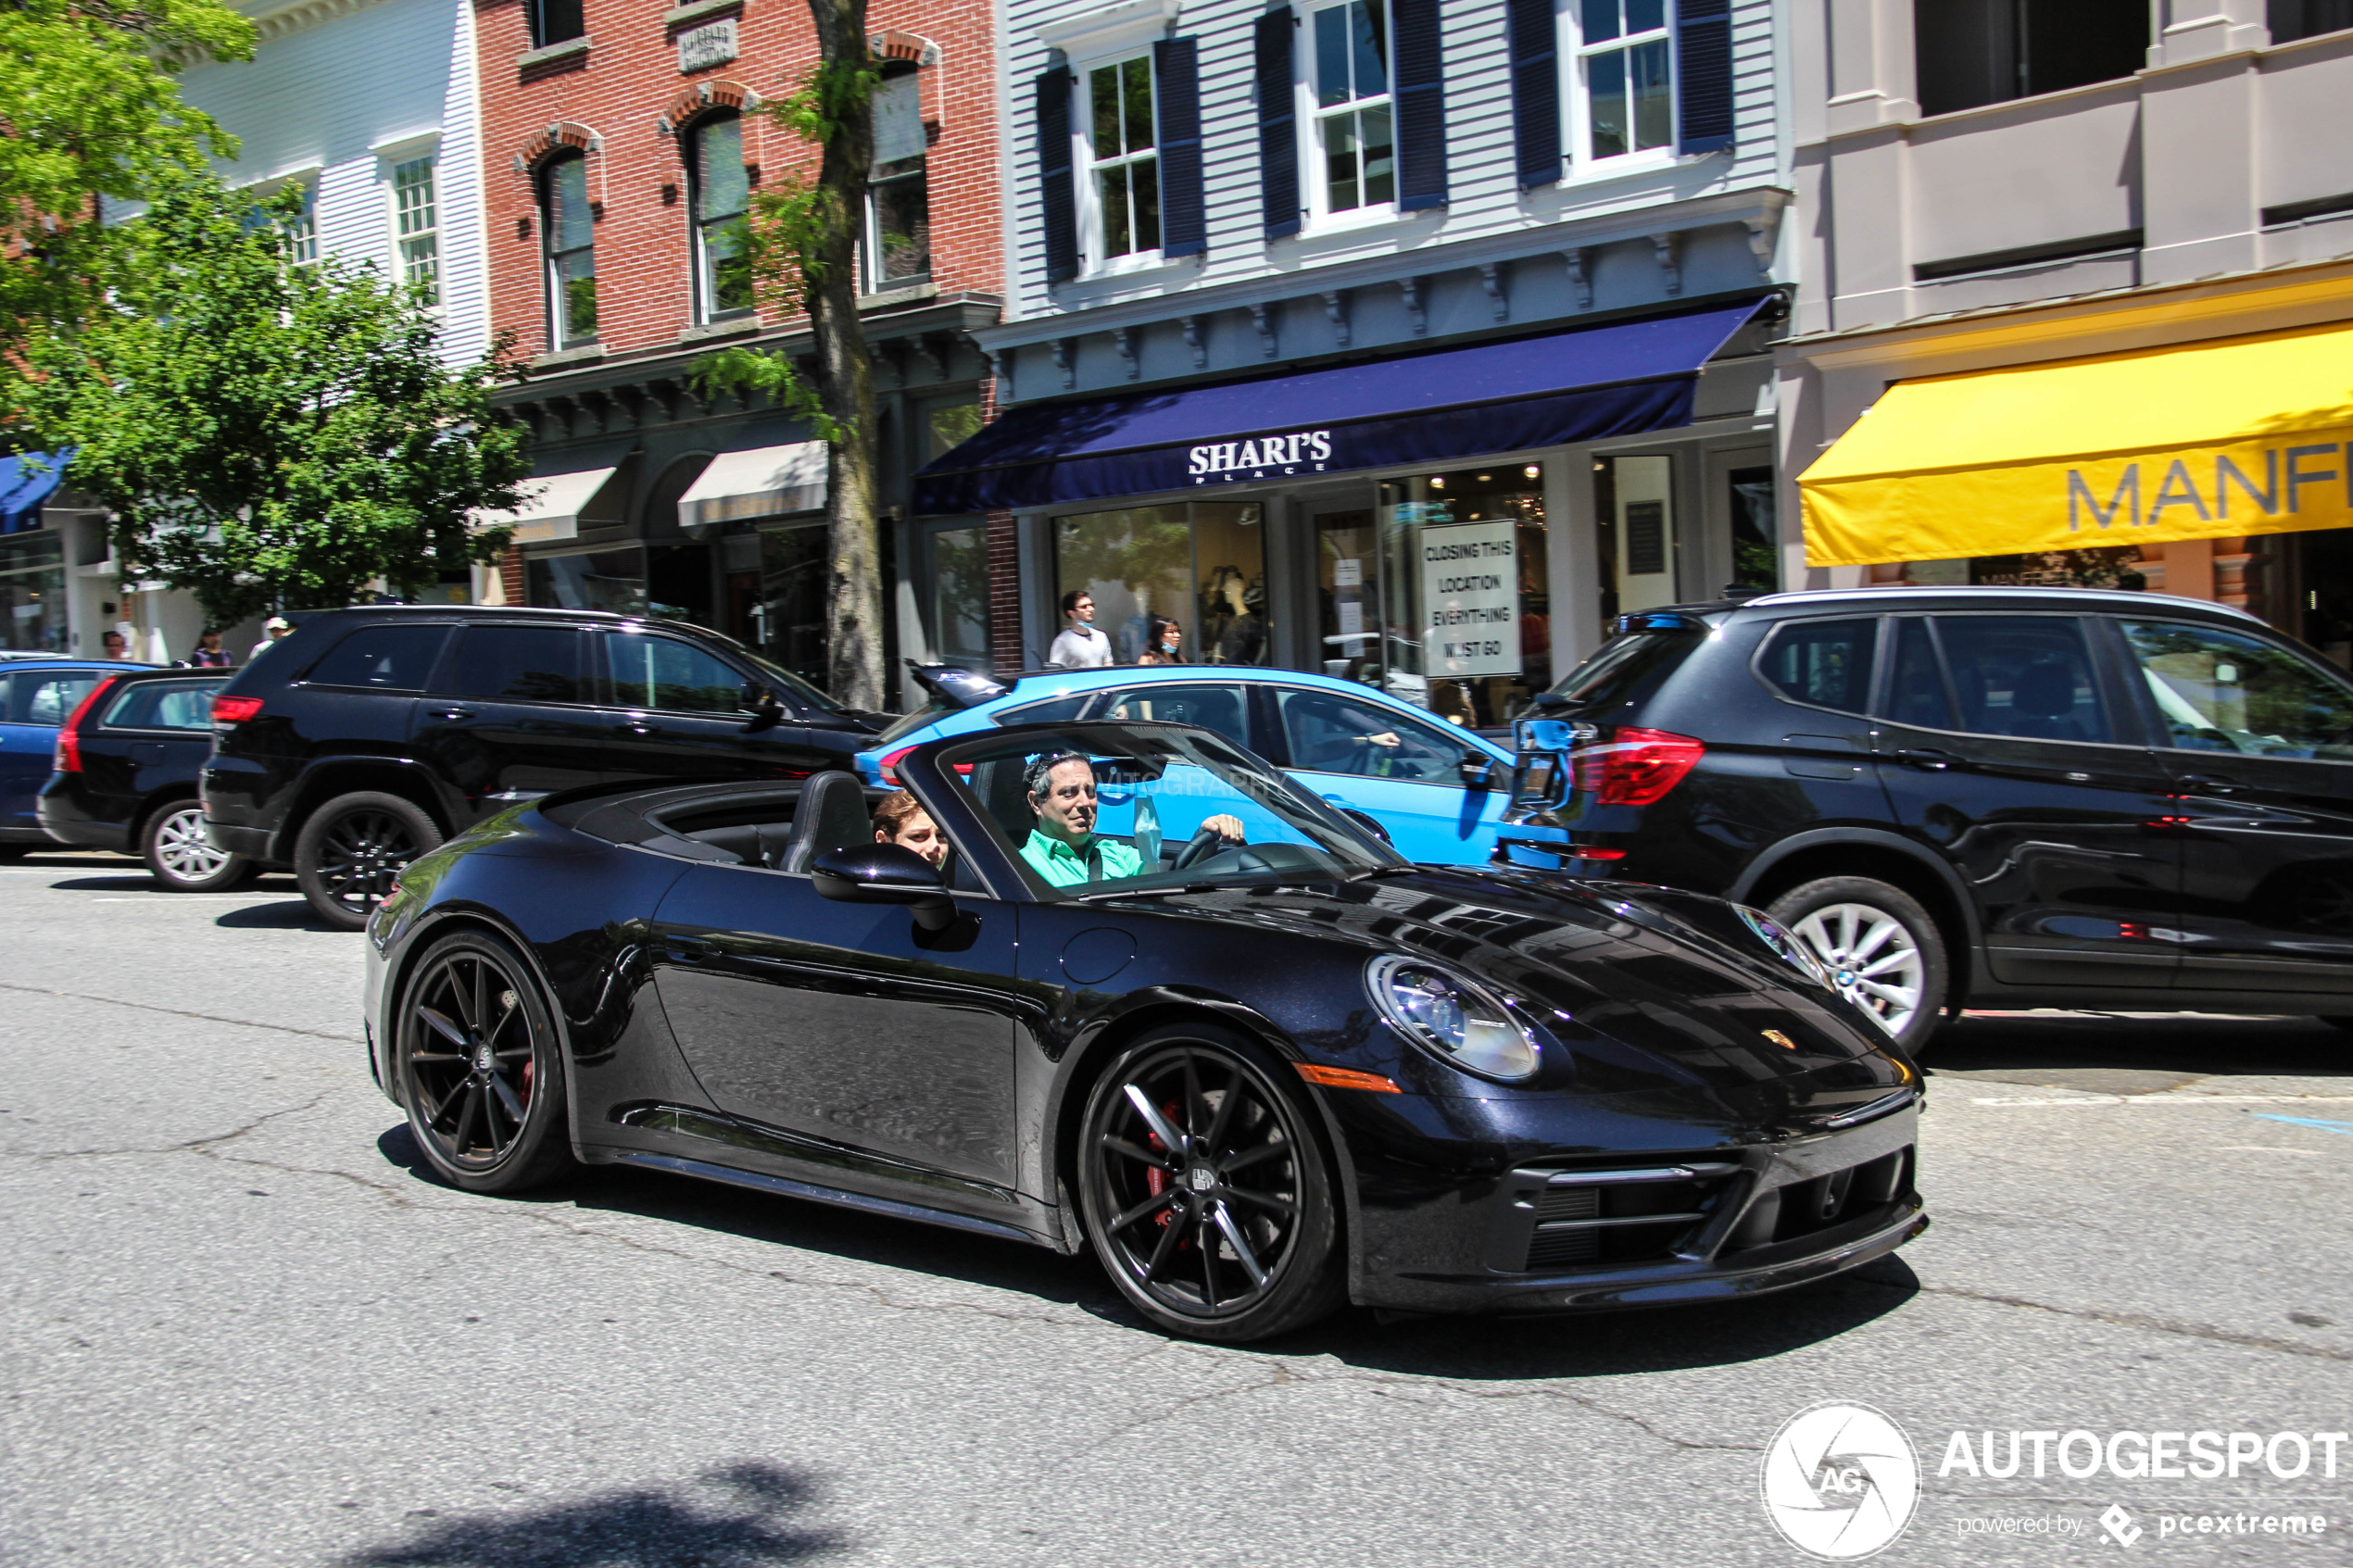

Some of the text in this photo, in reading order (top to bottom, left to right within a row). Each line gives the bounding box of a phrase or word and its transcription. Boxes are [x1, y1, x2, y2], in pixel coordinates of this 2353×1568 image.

[1189, 431, 1332, 474] SHARI'S
[1195, 463, 1325, 484] PLACE
[1425, 540, 1512, 561] CLOSING THIS
[1438, 575, 1502, 593] LOCATION
[1432, 607, 1511, 626] EVERYTHING
[1484, 641, 1502, 656] GO
